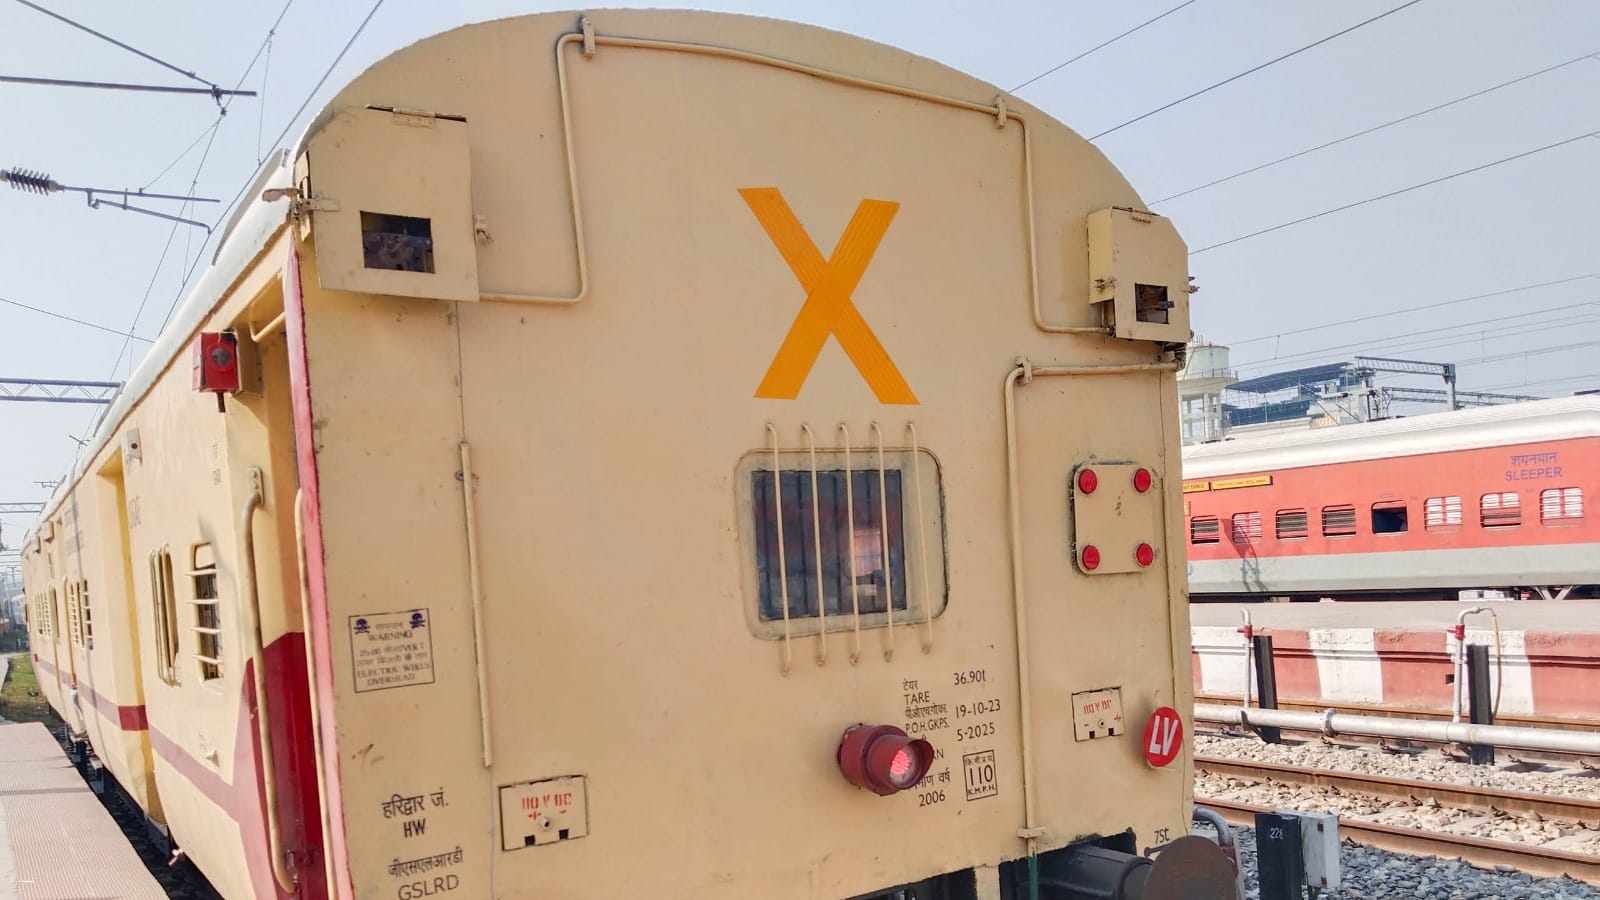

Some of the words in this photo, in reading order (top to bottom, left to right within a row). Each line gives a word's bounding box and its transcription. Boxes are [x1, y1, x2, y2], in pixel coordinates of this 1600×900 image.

[737, 187, 920, 405] X
[1505, 466, 1562, 481] SLEEPER
[903, 691, 930, 706] TARE
[955, 698, 1001, 719] 19-10-23
[957, 721, 995, 742] 5-2025
[1149, 715, 1179, 756] LV
[937, 767, 951, 783] वर्ष
[969, 764, 993, 786] 110
[381, 793, 425, 819] हरिद्वार
[918, 789, 946, 807] 2006
[403, 817, 426, 838] HW
[398, 874, 460, 900] GSLRD
